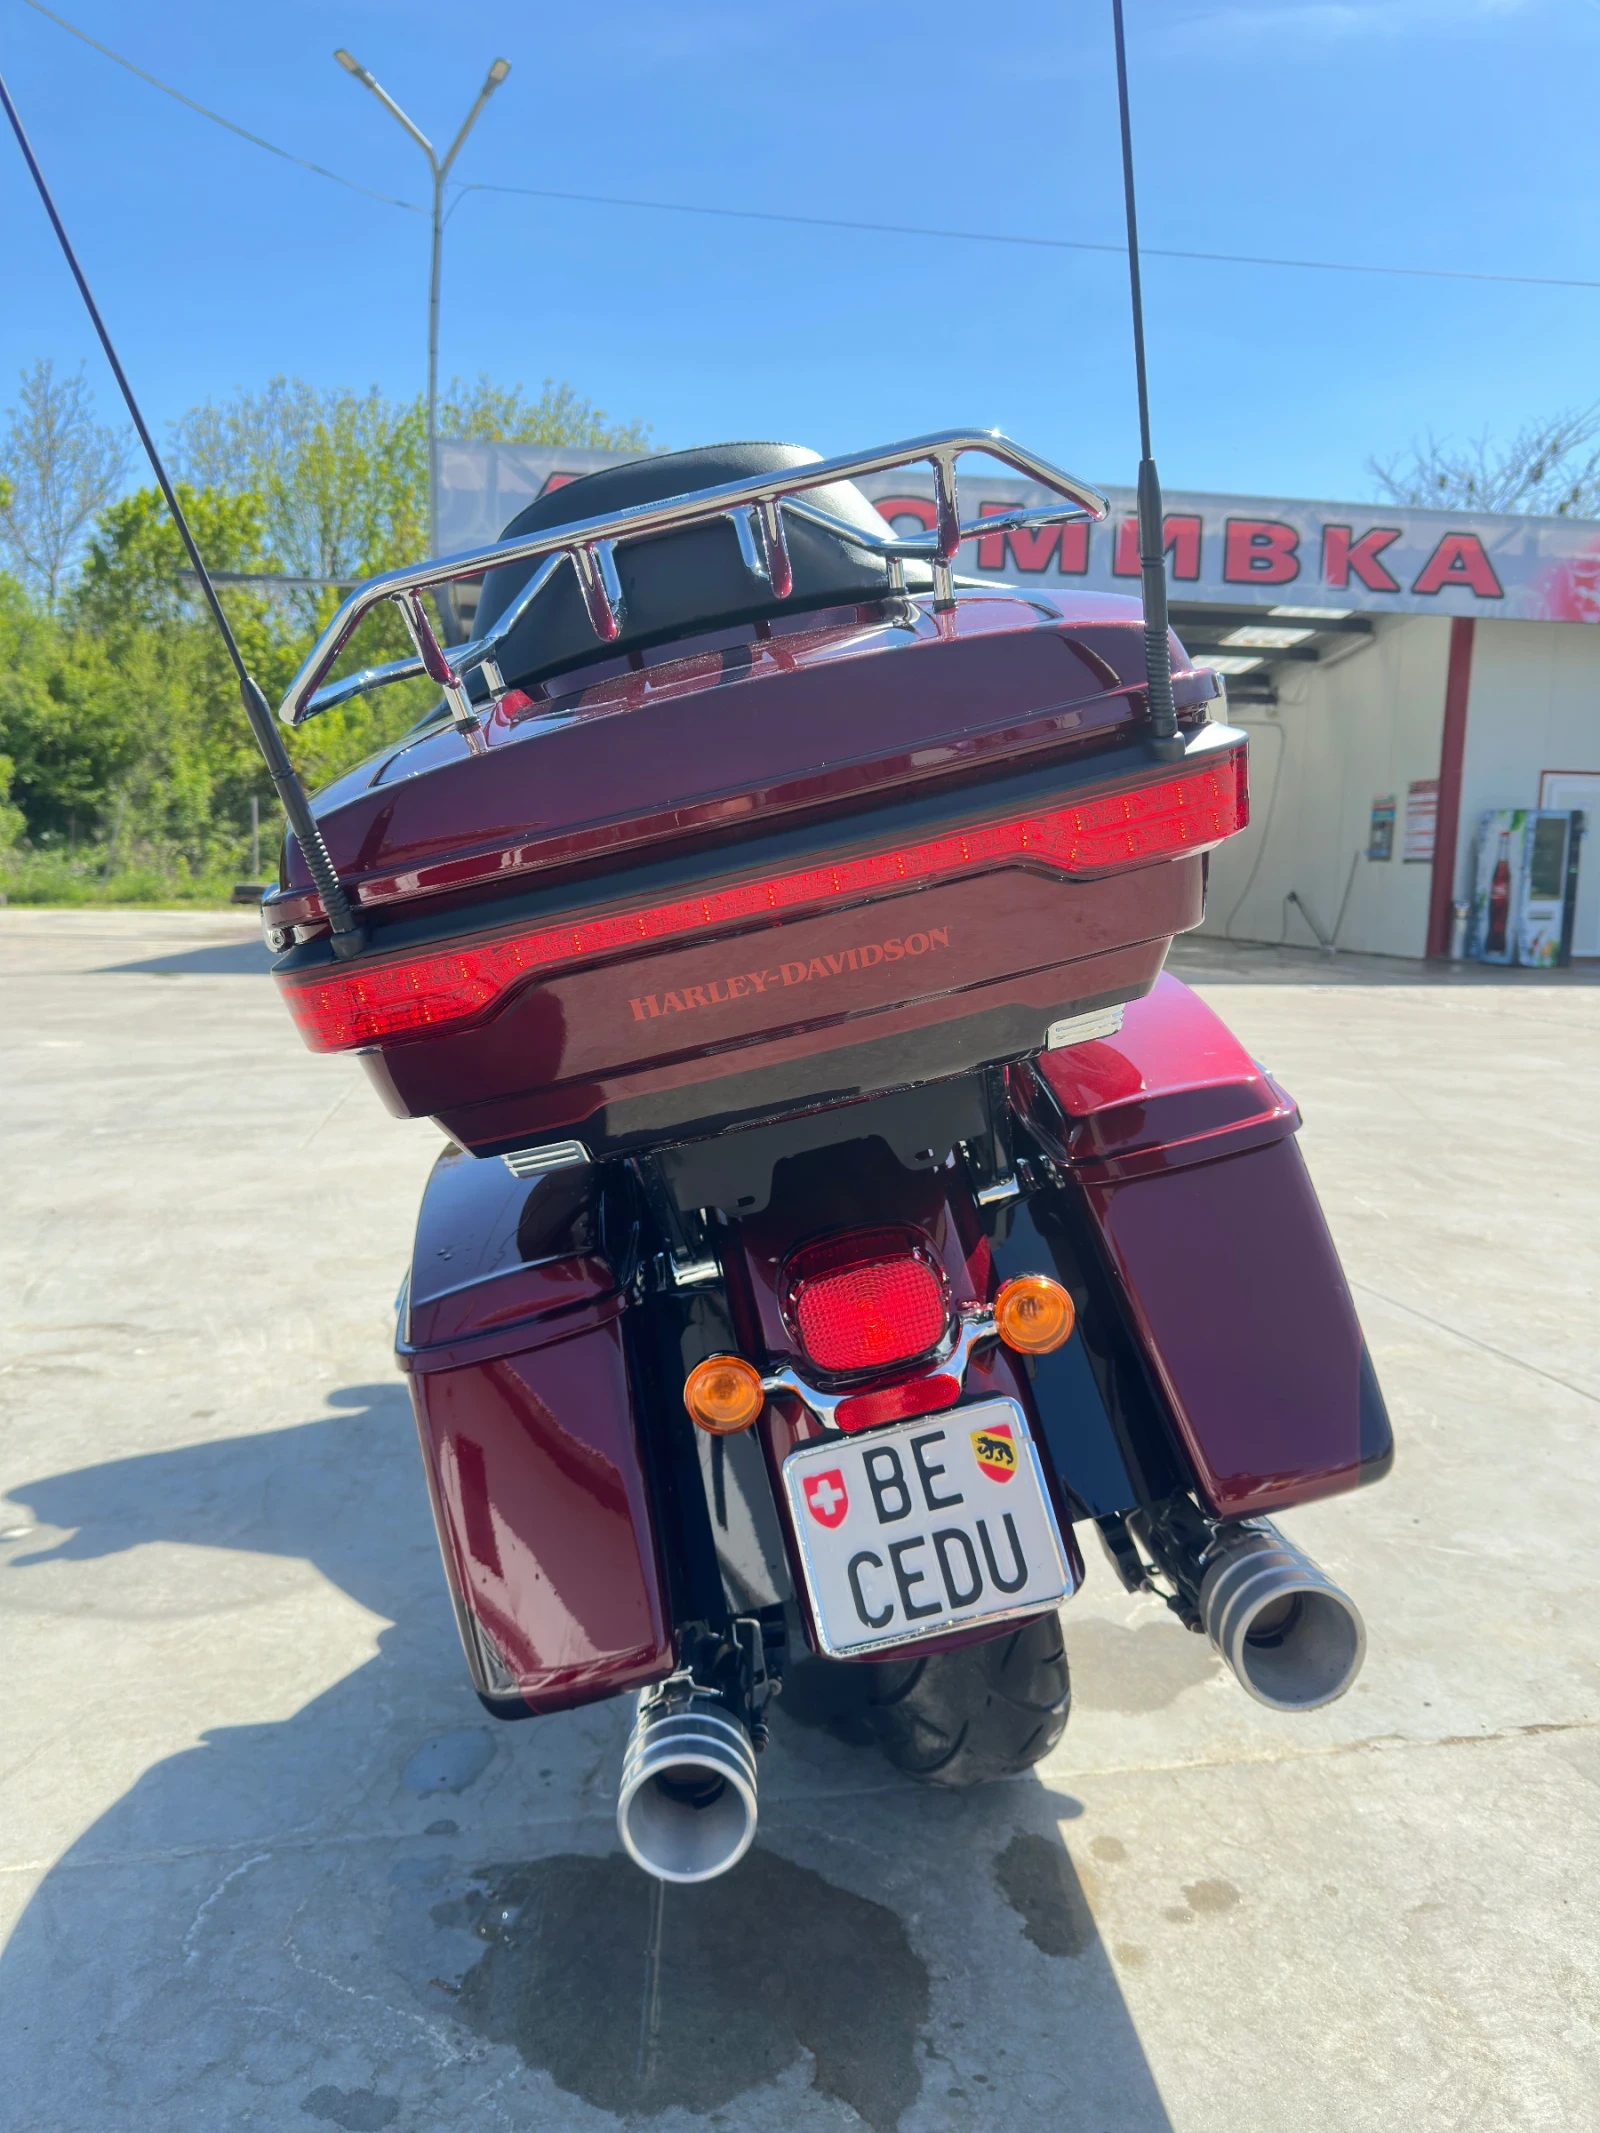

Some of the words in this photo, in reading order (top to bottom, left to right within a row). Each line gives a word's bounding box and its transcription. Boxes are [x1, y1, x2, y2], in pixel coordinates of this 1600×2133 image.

[628, 926, 951, 1022] HARLEY-DAVIDSON
[862, 1430, 965, 1525] BE
[847, 1512, 1029, 1630] CEDU
